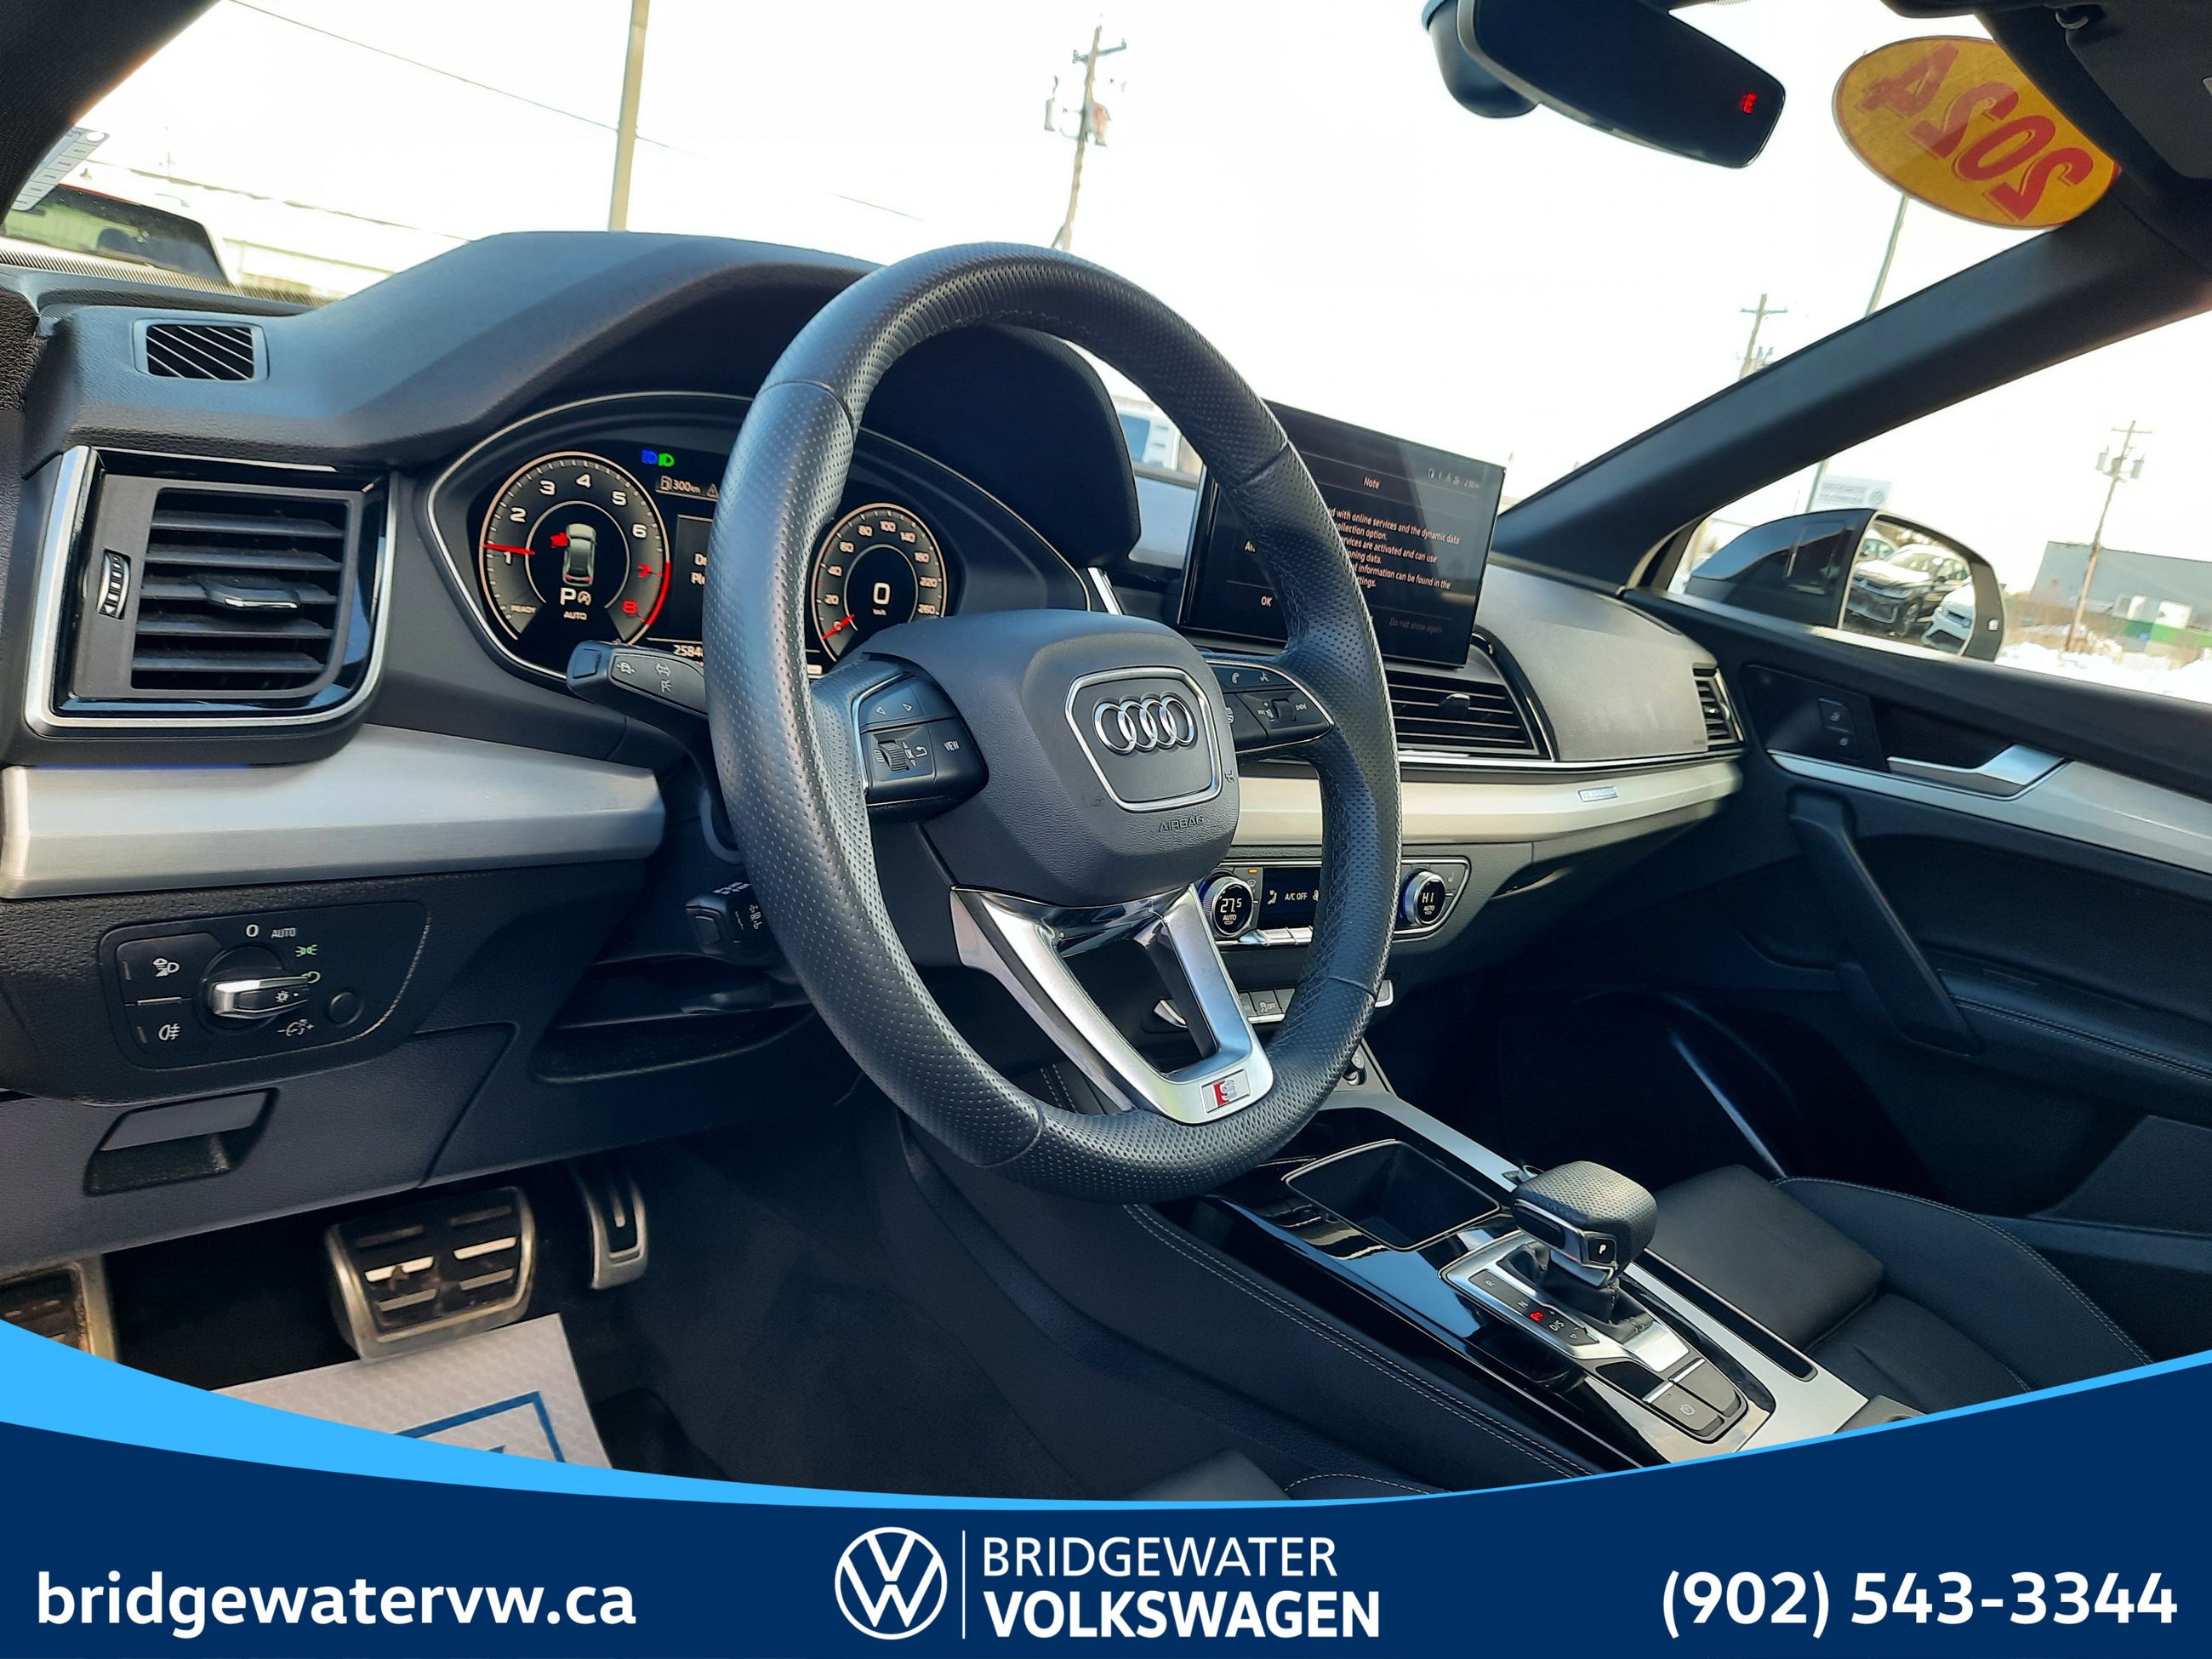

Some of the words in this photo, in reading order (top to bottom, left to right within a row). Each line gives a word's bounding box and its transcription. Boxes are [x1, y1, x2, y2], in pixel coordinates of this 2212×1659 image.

[576, 474, 591, 488] 4
[1363, 476, 1380, 489] Note
[539, 481, 556, 495] 3
[612, 491, 627, 505] 5
[510, 508, 526, 522] 2
[632, 524, 647, 539] 6
[1337, 510, 1351, 521] with
[1352, 513, 1371, 525] online
[1373, 517, 1397, 531] services
[1398, 523, 1410, 533] and
[1411, 526, 1421, 536] the
[1422, 529, 1445, 541] dynamic
[1446, 534, 1461, 544] data
[1365, 529, 1388, 541] option.
[504, 551, 512, 564] 1
[1363, 541, 1373, 550] are
[1374, 543, 1402, 556] activated
[1403, 549, 1414, 559] and
[1415, 552, 1426, 562] can
[1426, 556, 1438, 564] use
[1366, 553, 1382, 564] data.
[638, 565, 653, 579] 7
[1359, 564, 1394, 579] information
[1396, 572, 1406, 580] can
[1407, 573, 1416, 582] be
[1417, 574, 1433, 585] found
[1434, 578, 1440, 587] in
[1440, 579, 1451, 590] the
[560, 587, 577, 605] P
[873, 583, 891, 605] 0
[622, 601, 638, 615] 8
[1261, 596, 1273, 607] OK
[563, 611, 587, 620] AUTO
[943, 739, 960, 751] VIEW
[1158, 814, 1204, 832] AIRBAG
[1285, 892, 1296, 901] A/C
[1297, 892, 1308, 900] OFF
[1422, 892, 1434, 904] HI
[271, 928, 296, 939] AUTO
[1599, 1244, 1607, 1255] P
[1485, 1280, 1497, 1288] R
[1517, 1299, 1529, 1308] N
[1548, 1320, 1565, 1331] D/S
